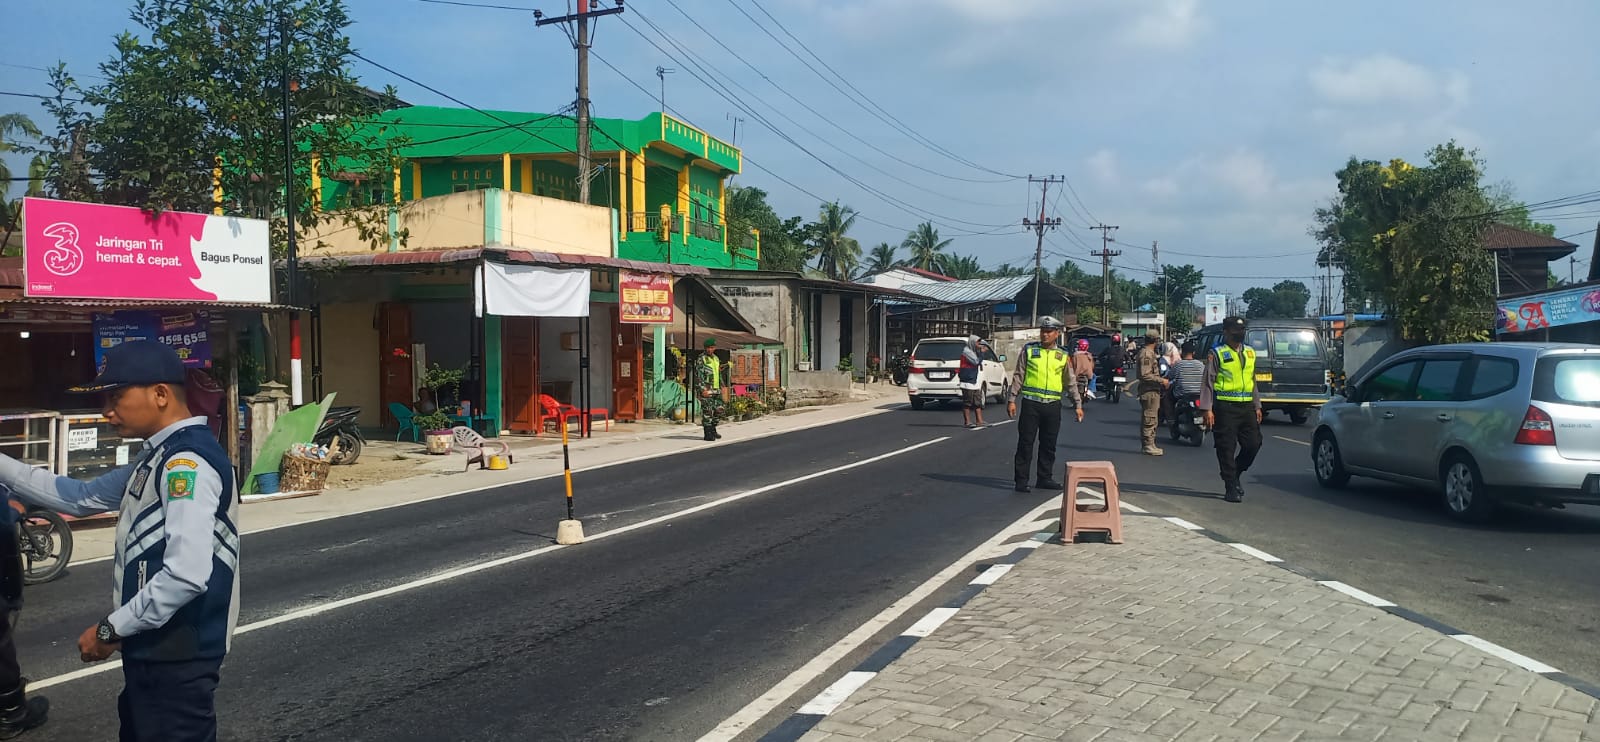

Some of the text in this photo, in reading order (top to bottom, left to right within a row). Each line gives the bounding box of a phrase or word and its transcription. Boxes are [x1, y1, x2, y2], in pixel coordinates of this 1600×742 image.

[96, 235, 163, 251] Jaringan Tri
[96, 251, 182, 267] hemat & cepat.
[200, 251, 263, 264] Bagus Ponsel
